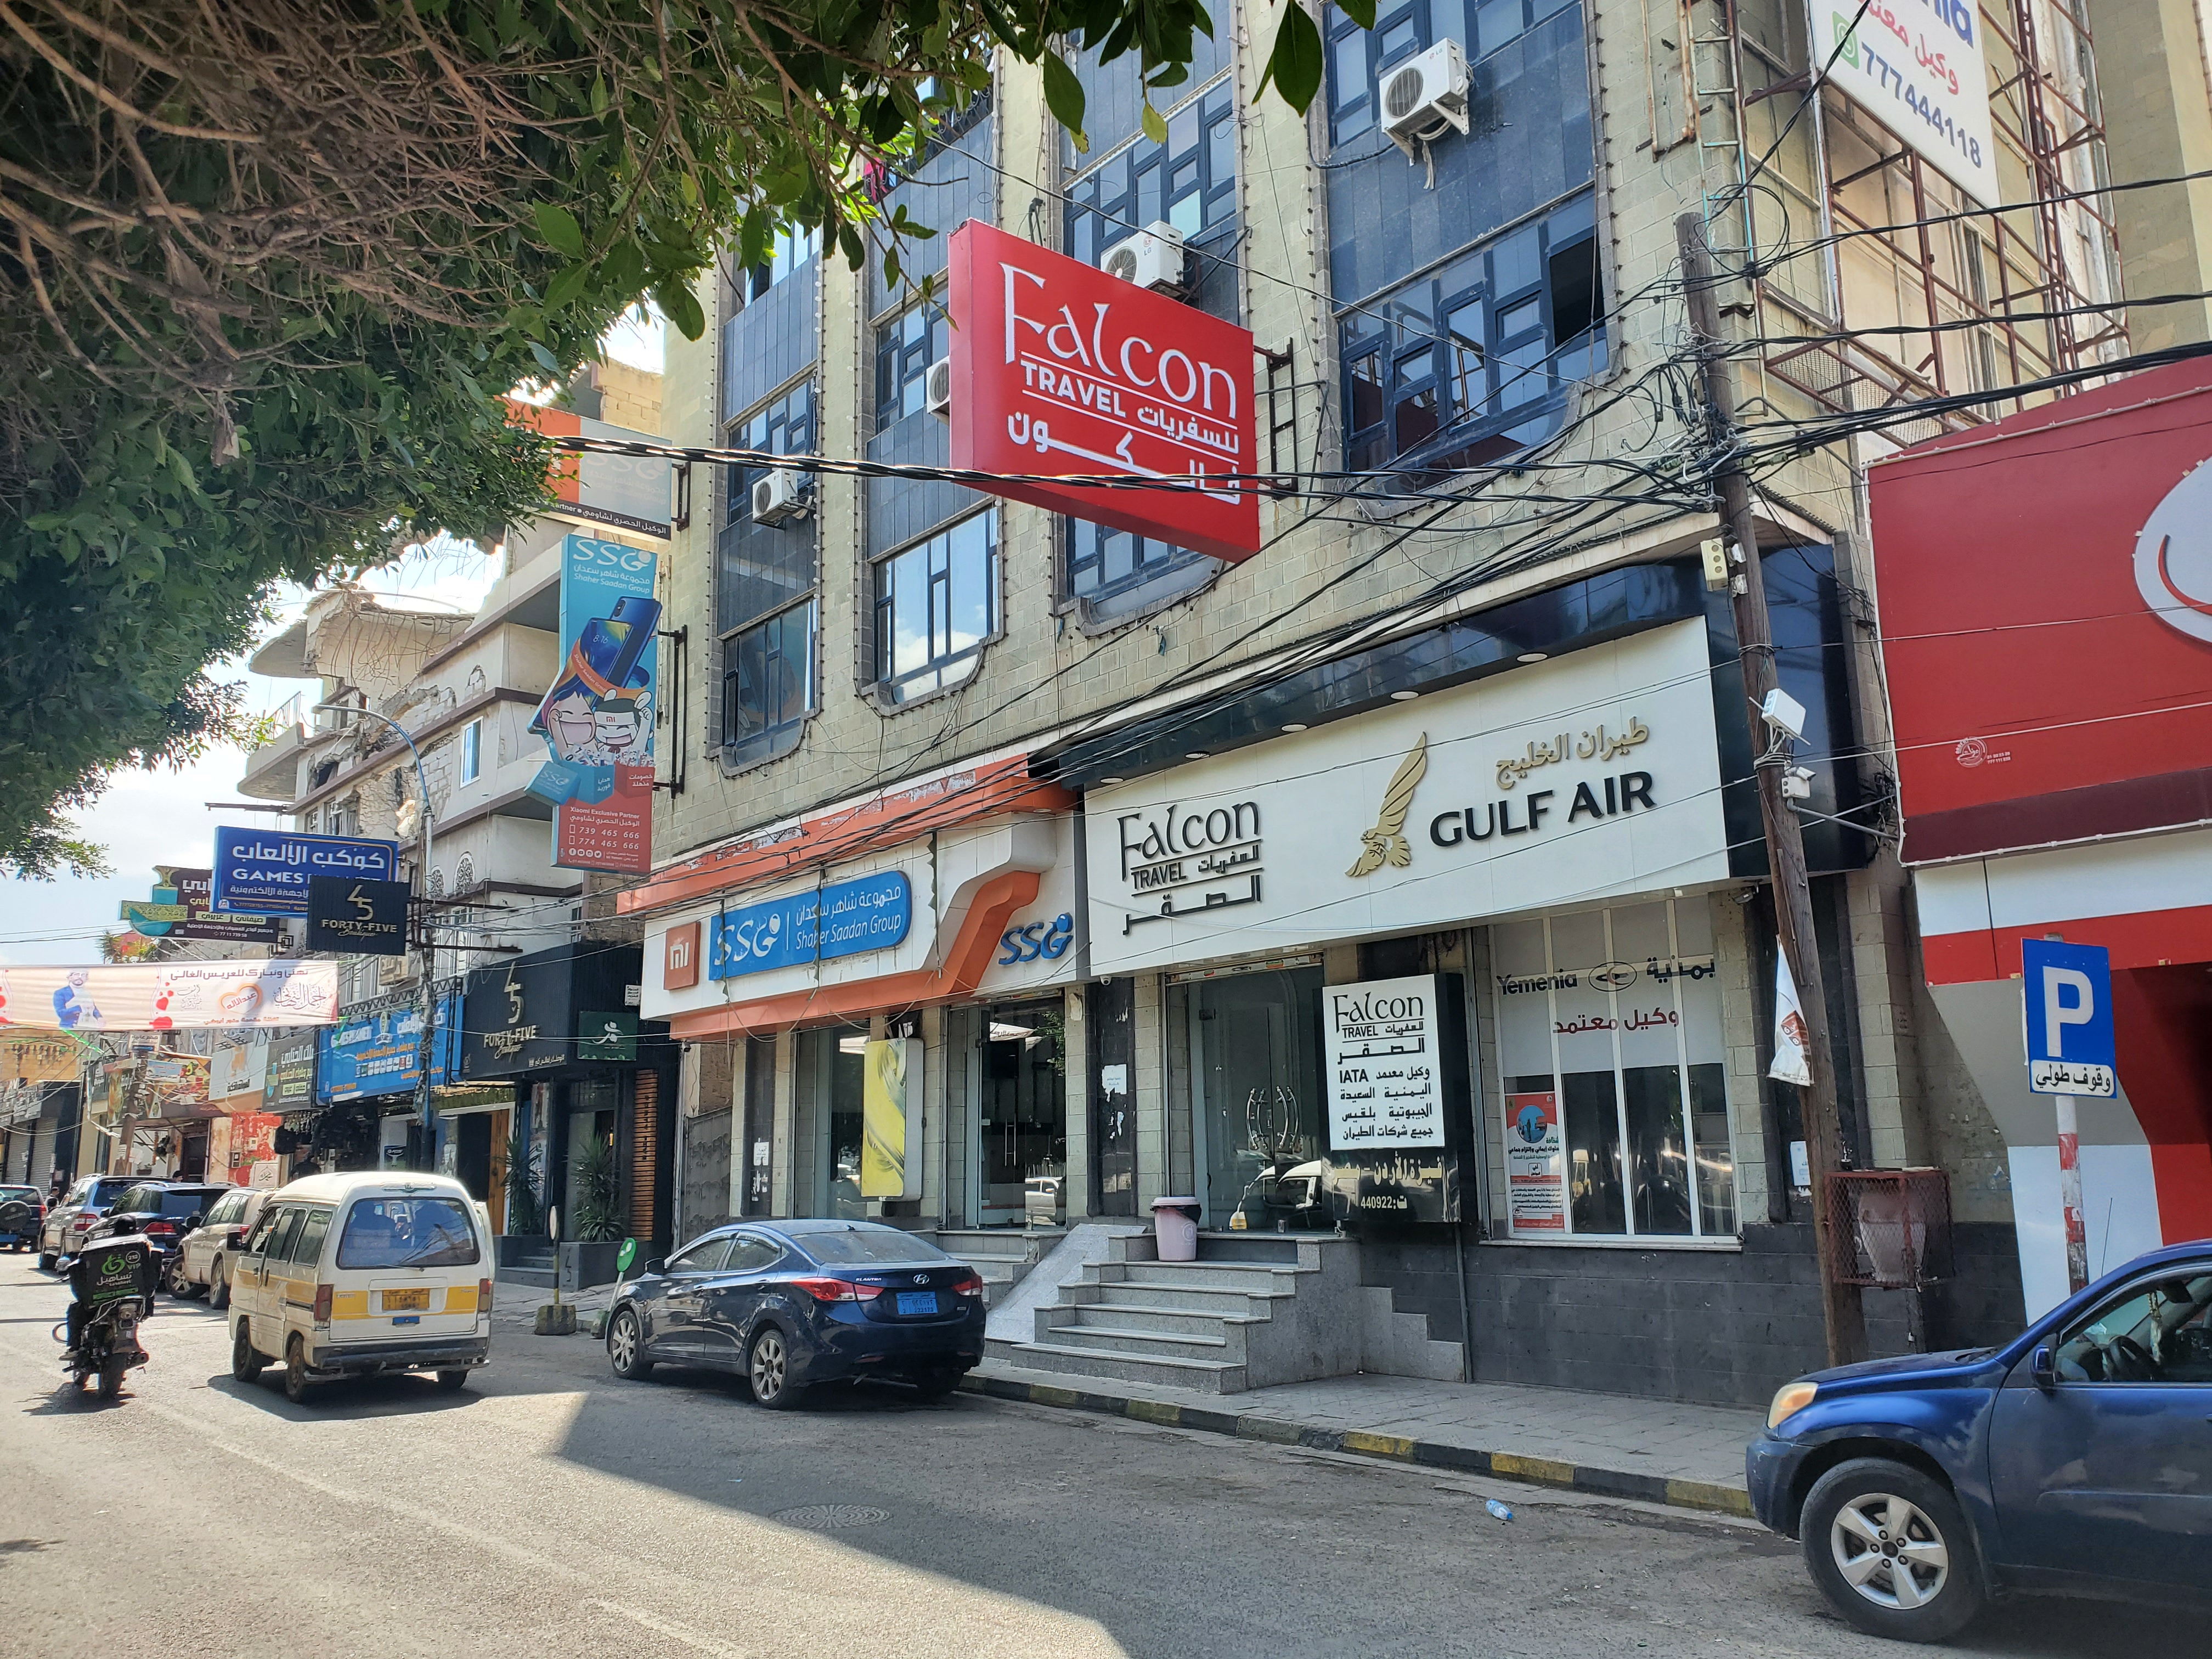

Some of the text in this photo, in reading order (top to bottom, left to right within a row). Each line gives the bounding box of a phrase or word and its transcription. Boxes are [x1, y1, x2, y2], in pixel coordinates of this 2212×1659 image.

[1915, 33, 1959, 95] وكيل
[1861, 41, 1982, 168] 777444118
[1144, 247, 1152, 256] LG
[999, 262, 1237, 420] Falcon
[1020, 359, 1127, 418] TRAVEL
[1137, 407, 1239, 455] للسفريات
[552, 503, 576, 512] artner
[583, 510, 666, 534] الوكيل الحصري لشاومي
[573, 539, 652, 571] SSG
[574, 564, 650, 585] مجموعة شاهر سعدان
[574, 573, 650, 594] Shaher Saadan Group
[593, 635, 608, 644] 8:16
[1496, 716, 1650, 789] طيران الخليج
[591, 809, 618, 817] Exclusive
[1430, 771, 1657, 847] GULF AIR
[233, 841, 385, 870] كوكب الألعاب
[1117, 801, 1261, 882] Falcon
[1198, 844, 1260, 873] للسفريات
[232, 868, 304, 884] GAMES
[1131, 862, 1187, 890] TRAVEL
[830, 890, 858, 919] شاهر
[859, 885, 901, 909] مجموعة
[1122, 874, 1262, 935] الصقر
[321, 919, 398, 933] FORTY-FIVE
[714, 913, 781, 966] SSG
[830, 919, 868, 943] Saadan
[870, 914, 901, 935] Group
[998, 912, 1074, 965] SSG
[1496, 968, 1578, 995] Yemenia
[1333, 991, 1423, 1034] Falcon
[1553, 1007, 1679, 1034] وكيل معتمد
[2042, 966, 2094, 1058] P
[484, 1025, 537, 1048] FORTY-FIVE
[1342, 1025, 1378, 1038] TRAVEL
[1385, 1021, 1423, 1035] للسفريات
[1338, 1037, 1425, 1065] الصقر
[1340, 1069, 1369, 1083] IATA
[1407, 1066, 1430, 1080] وكيل
[2036, 1063, 2111, 1092] وقوف طولي
[1340, 1082, 1431, 1103] اليمنية السعيدة
[1342, 1103, 1432, 1122] الجيبوتية بلقيس
[1343, 1125, 1433, 1141] جميع شركات الطيران
[1374, 1150, 1407, 1186] الأردن
[1410, 1155, 1442, 1186] فيزة
[97, 1272, 133, 1286] تساهيل
